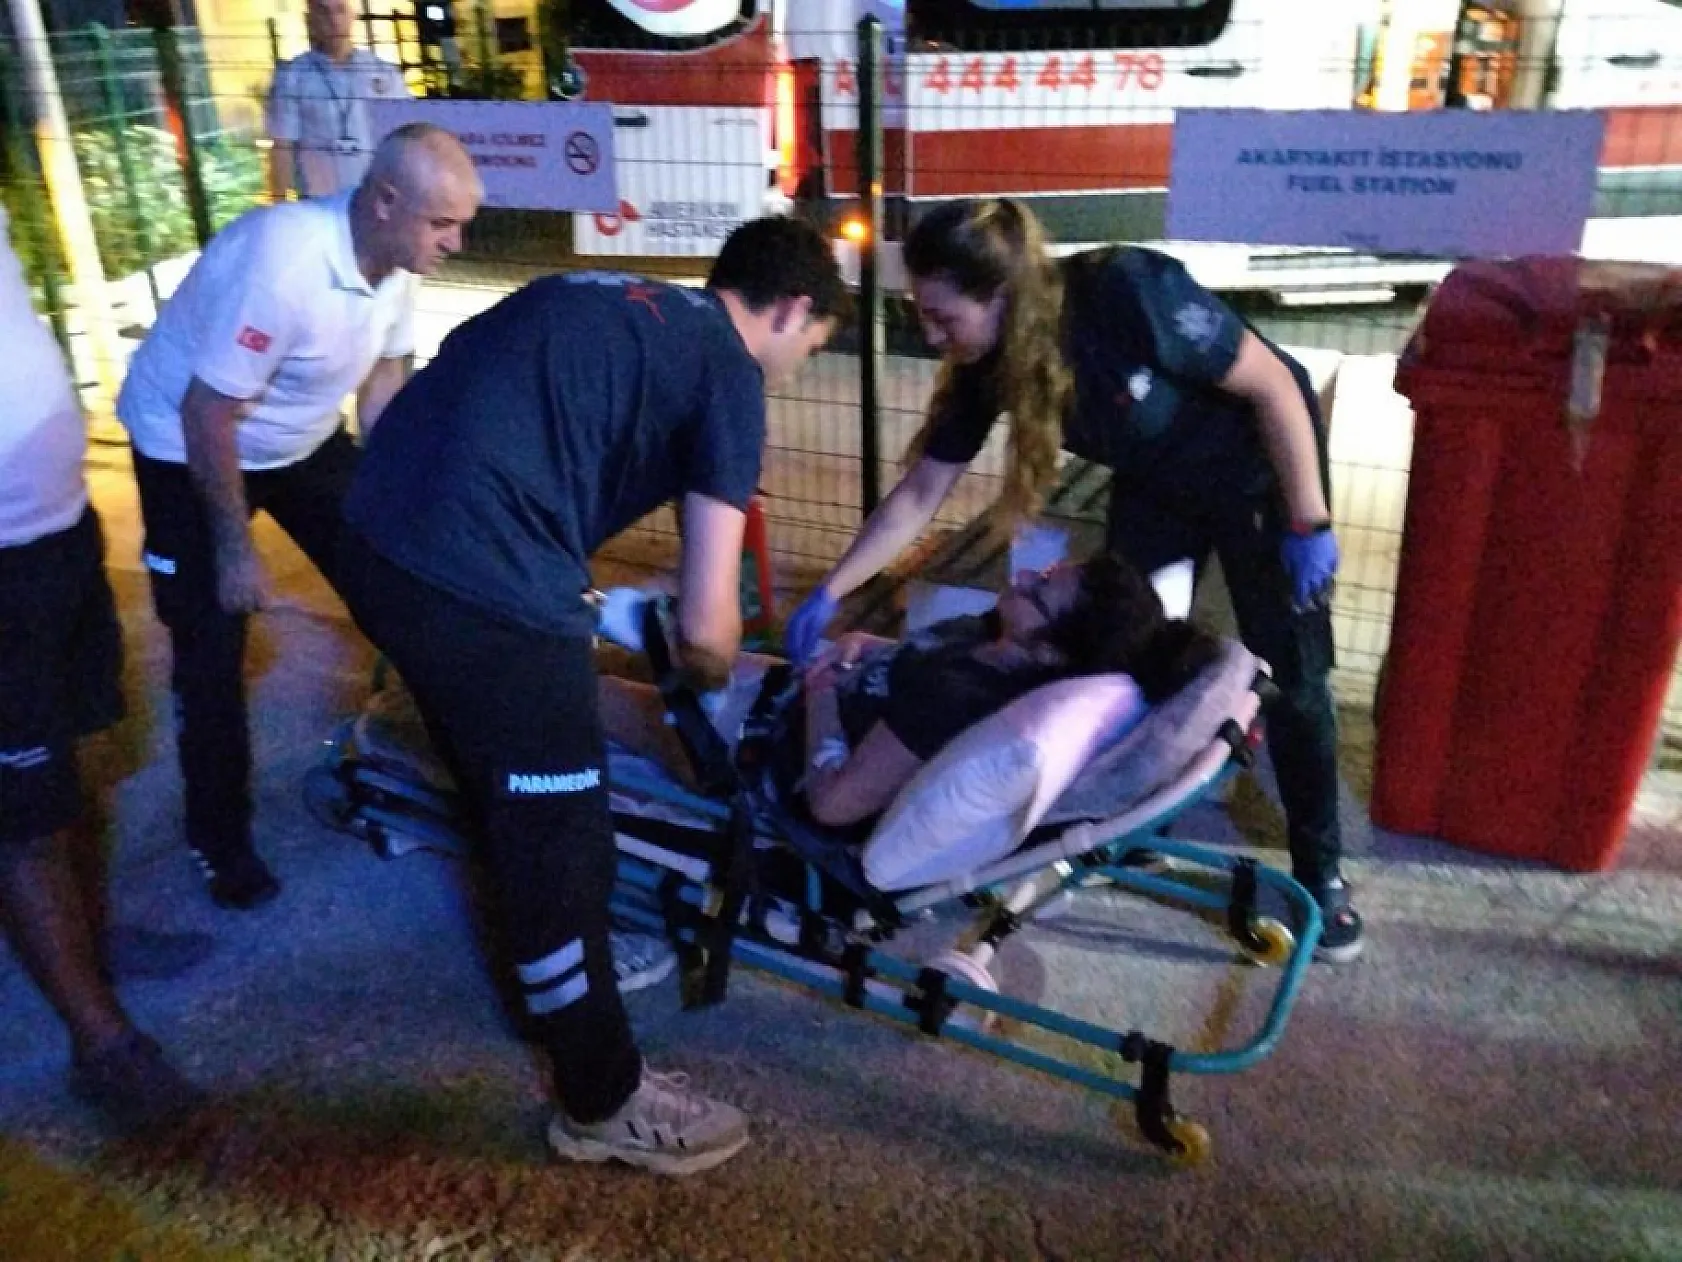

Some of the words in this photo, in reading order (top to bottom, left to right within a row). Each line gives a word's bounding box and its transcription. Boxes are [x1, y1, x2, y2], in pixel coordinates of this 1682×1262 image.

[924, 56, 1020, 94] 444
[1036, 56, 1097, 92] 44
[1113, 53, 1167, 91] 78
[1352, 175, 1456, 195] STATION
